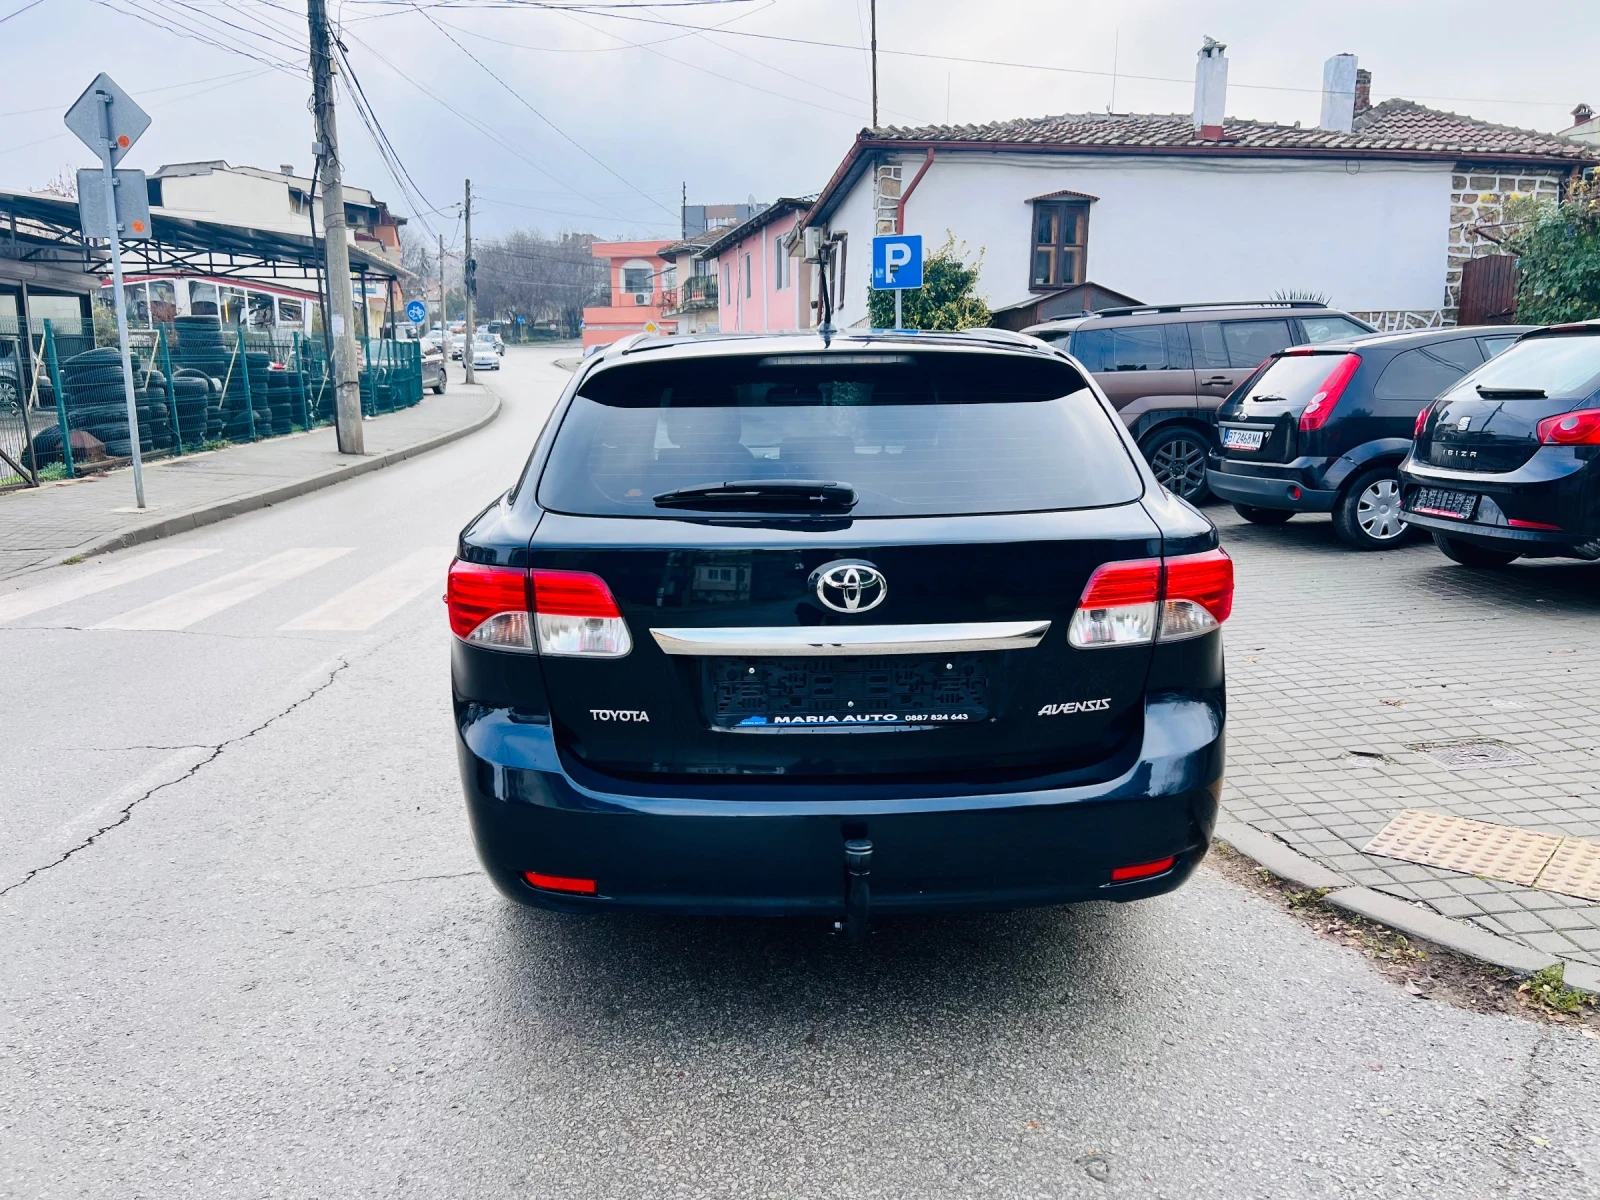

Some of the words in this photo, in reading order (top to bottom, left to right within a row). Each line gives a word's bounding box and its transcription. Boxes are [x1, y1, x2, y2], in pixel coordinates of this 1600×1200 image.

[885, 243, 912, 283] P
[1443, 449, 1478, 458] IBIZA
[1037, 698, 1112, 716] AVENSIS
[589, 709, 650, 722] TOYOTA
[774, 715, 839, 724] MARIA
[841, 714, 898, 722] AUTO
[930, 713, 949, 721] 824
